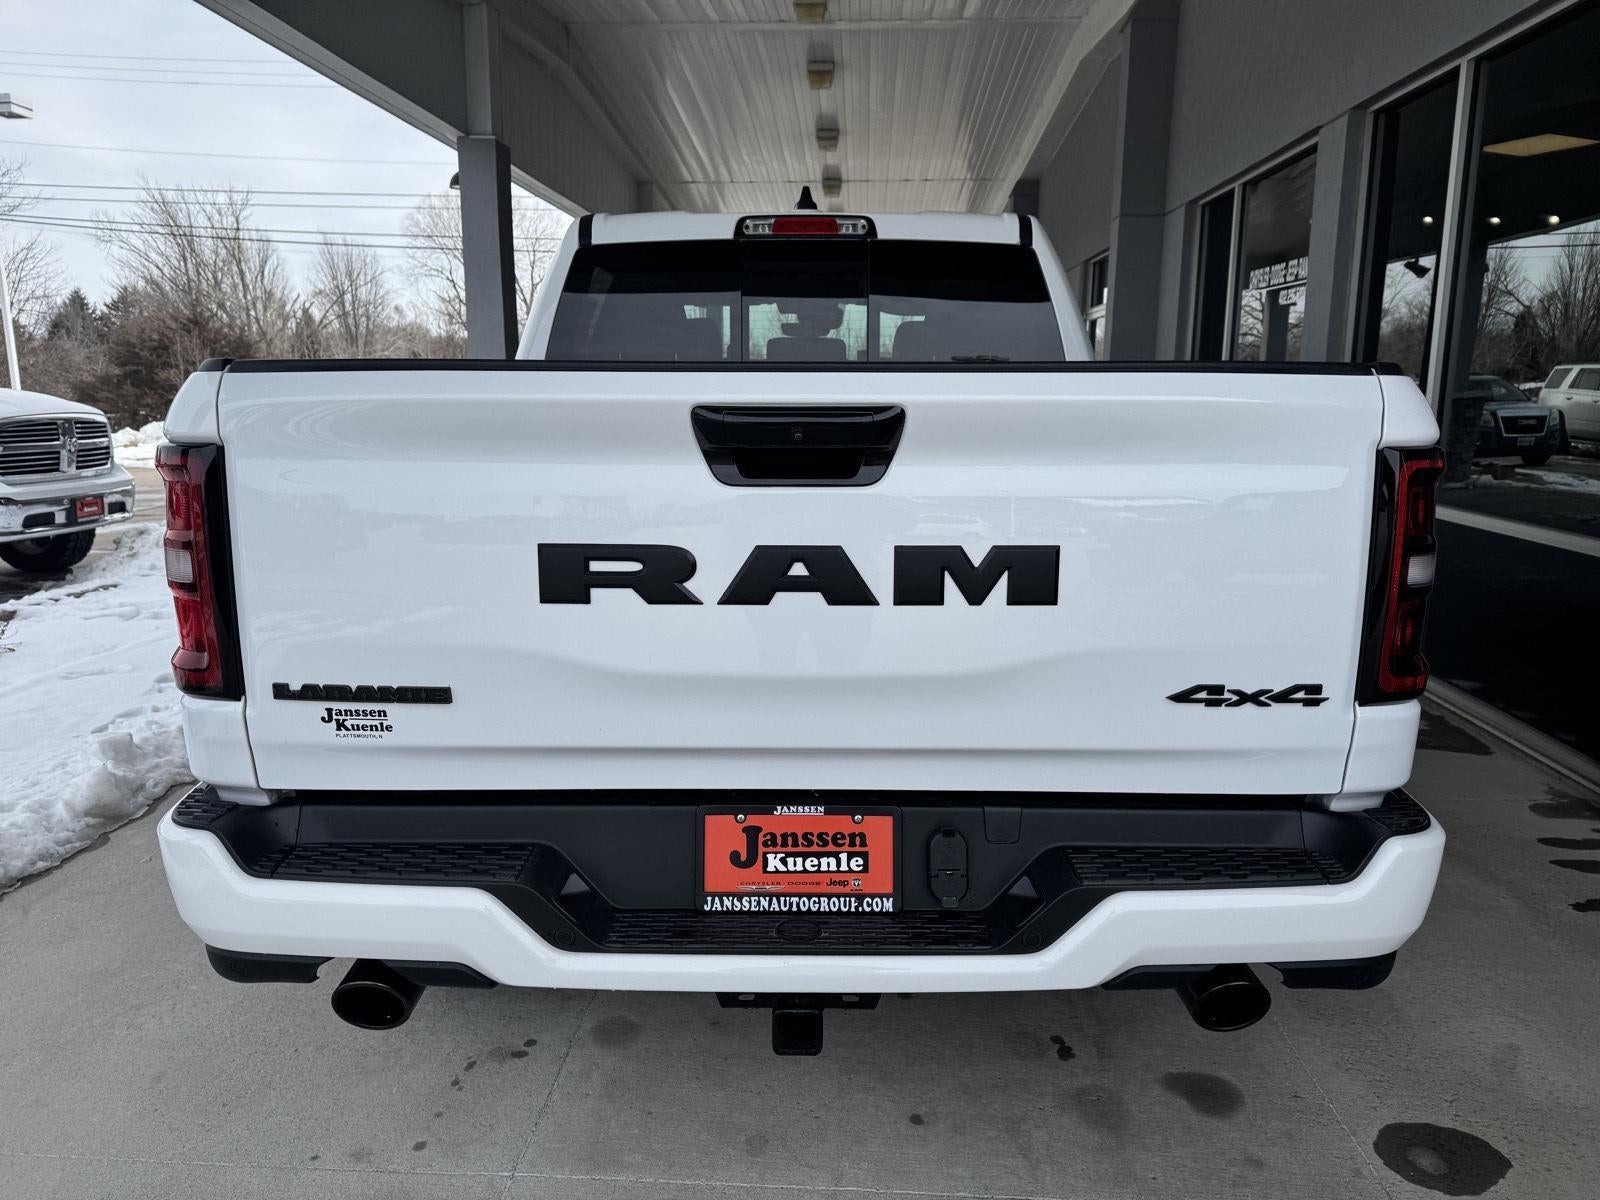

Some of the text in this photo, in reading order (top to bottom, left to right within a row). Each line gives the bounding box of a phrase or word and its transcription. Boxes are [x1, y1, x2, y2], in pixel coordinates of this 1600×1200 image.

[538, 543, 1060, 606] RAM
[272, 682, 453, 704] LARAMIE
[1165, 684, 1330, 707] 4x4
[321, 708, 388, 723] Janssen
[334, 718, 393, 732] Kuenle
[774, 805, 825, 815] JANSSEN
[729, 825, 868, 869] Janssen
[766, 852, 864, 872] Kuenle
[826, 878, 849, 888] Jeep
